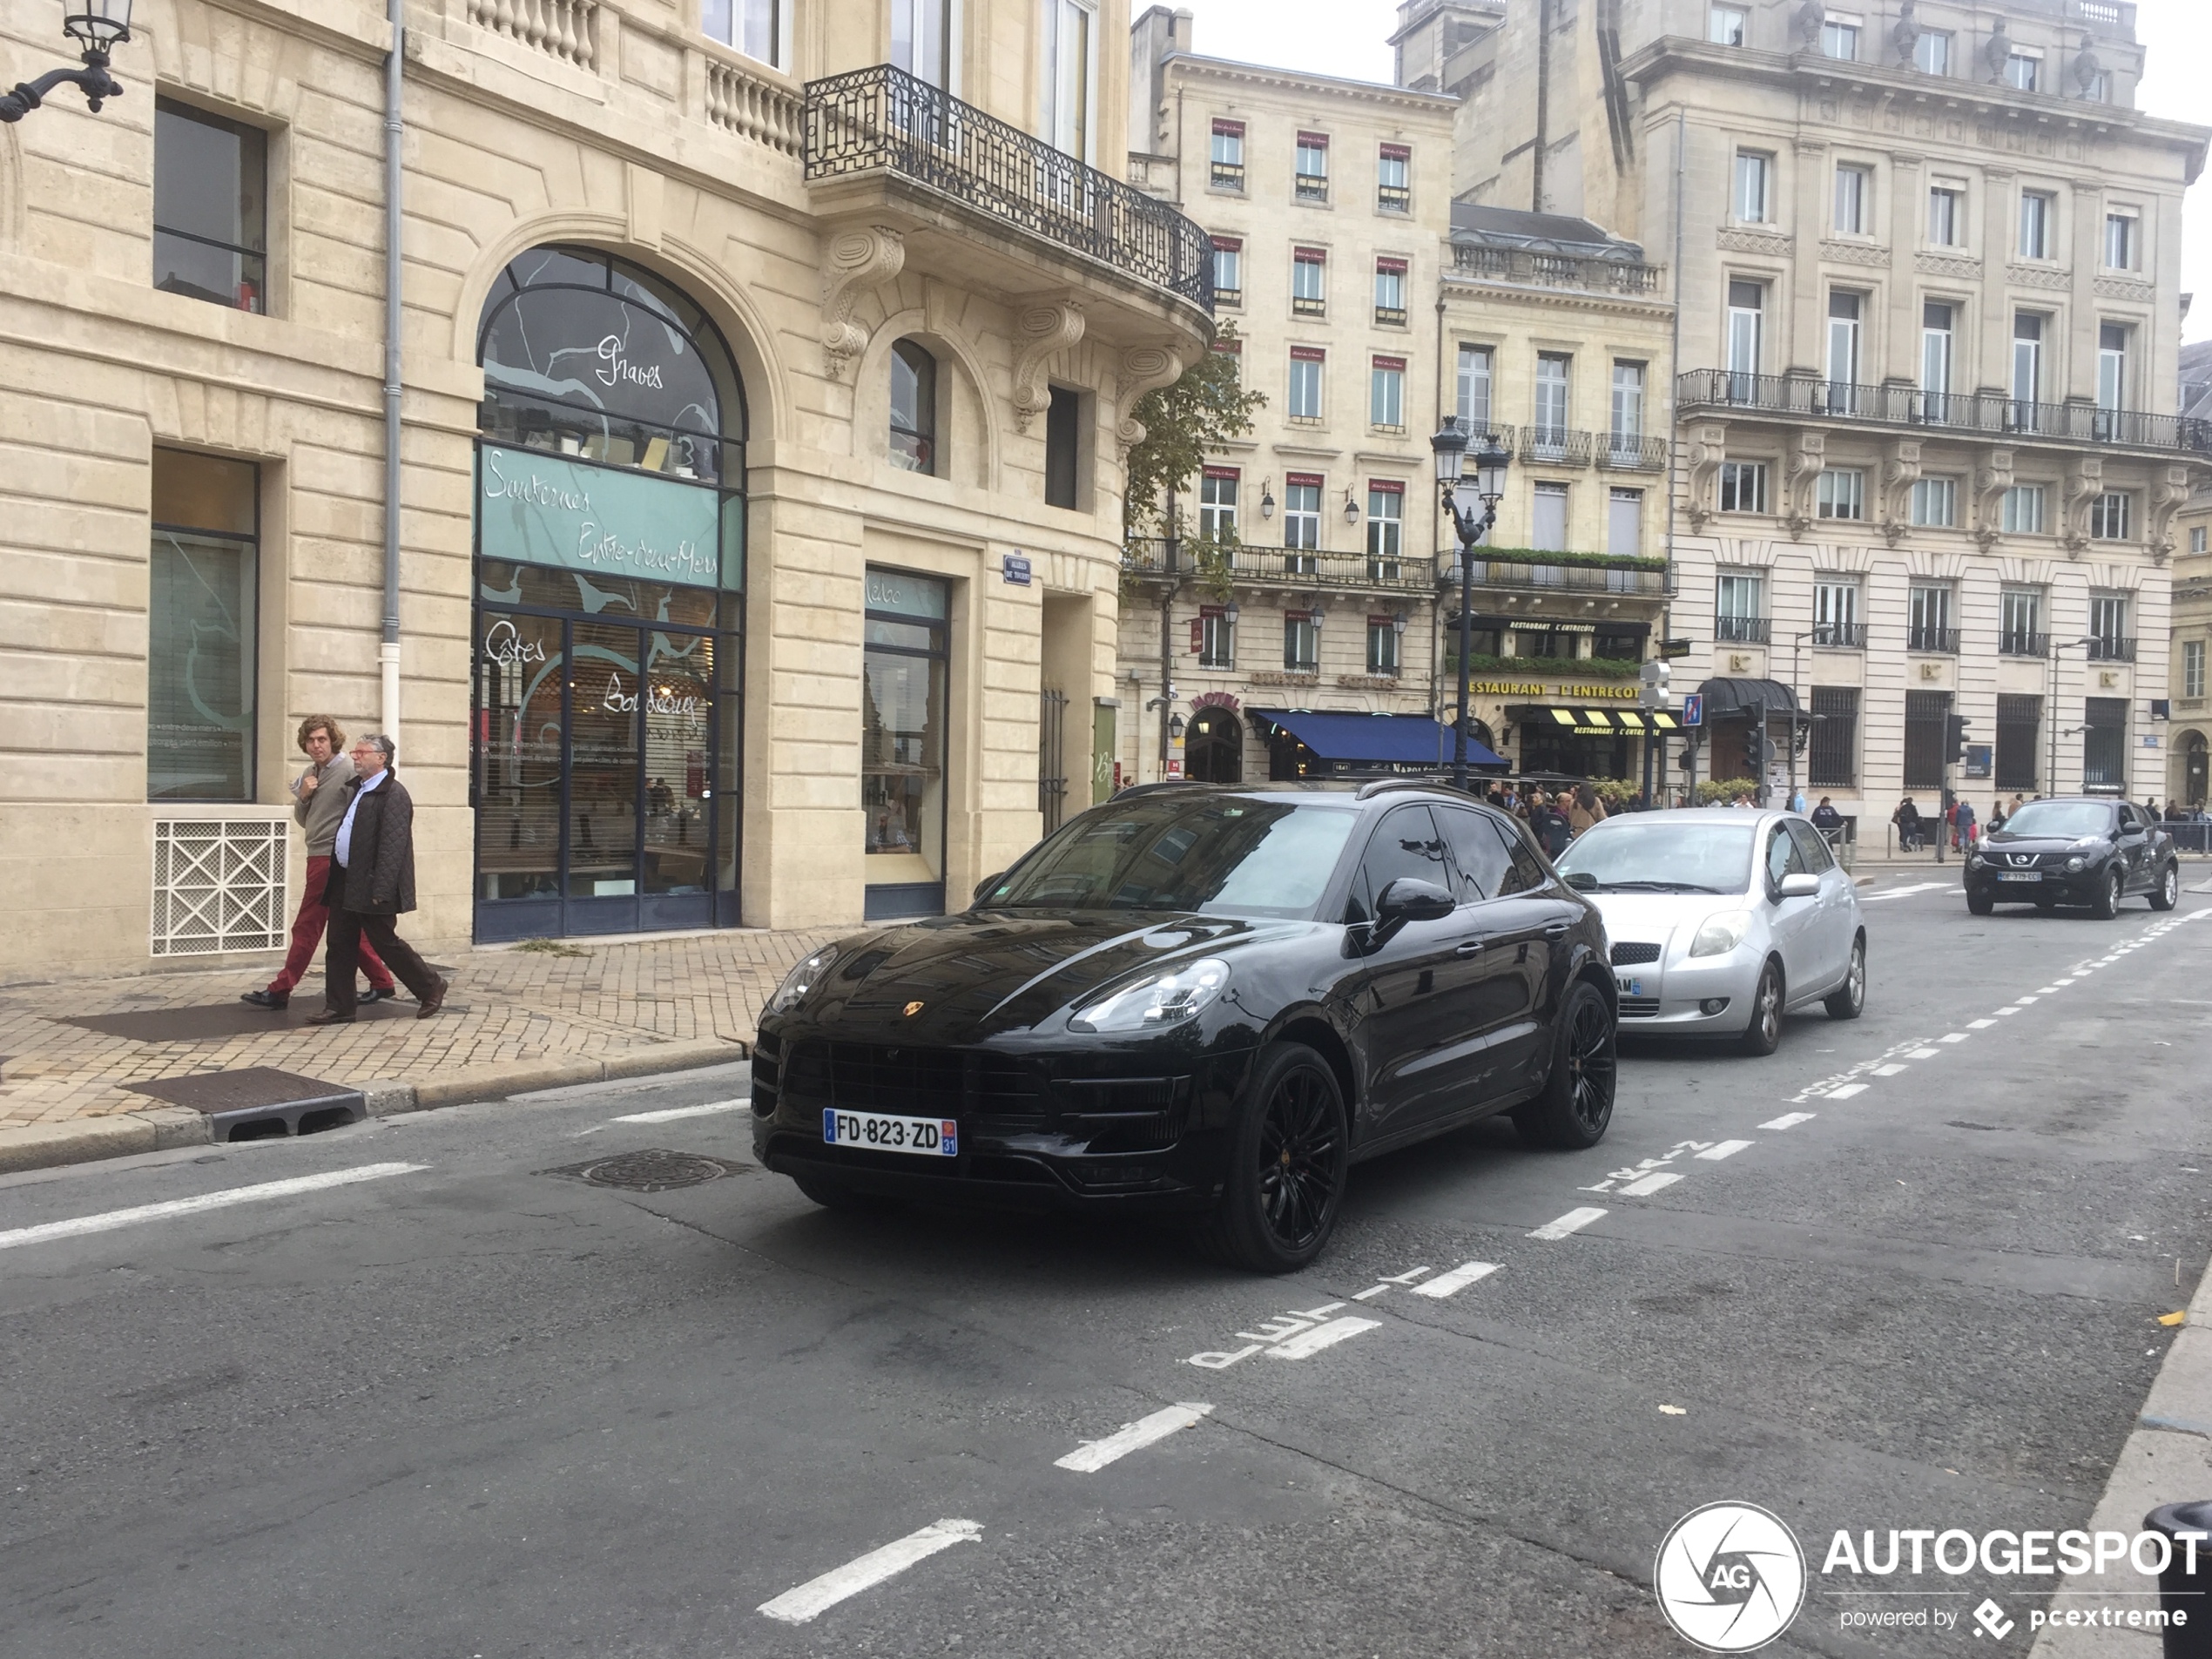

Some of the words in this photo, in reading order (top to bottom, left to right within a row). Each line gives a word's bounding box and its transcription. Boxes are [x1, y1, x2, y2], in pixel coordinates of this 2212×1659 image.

[596, 335, 664, 389] Graves
[1509, 621, 1551, 631] RESTAURANT
[1191, 691, 1241, 713] HOTEL
[1574, 726, 1615, 735] RESTAURANT
[943, 1138, 955, 1153] 31
